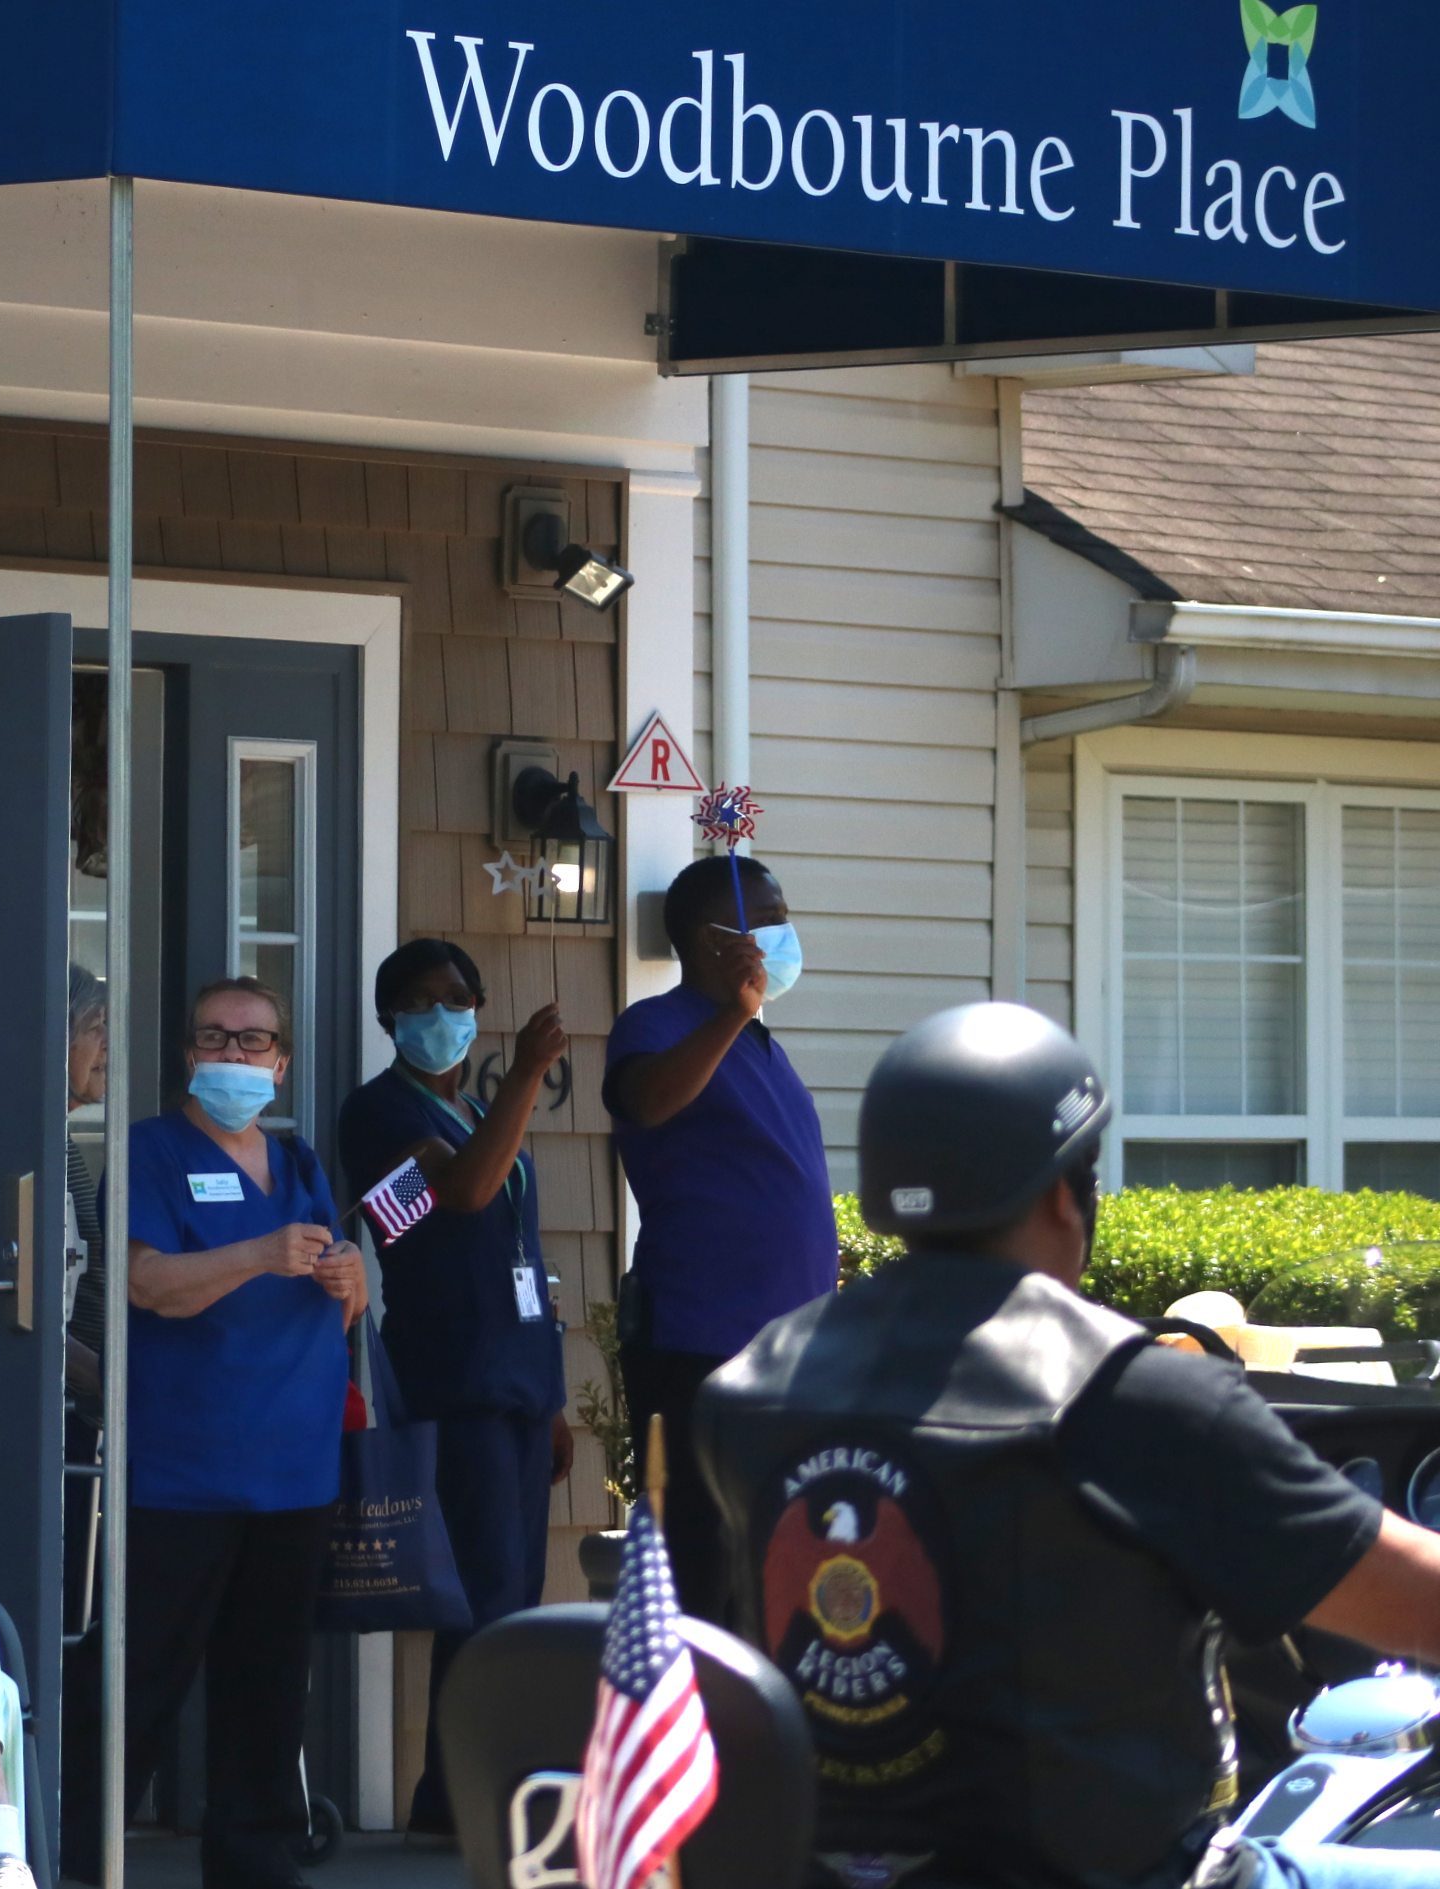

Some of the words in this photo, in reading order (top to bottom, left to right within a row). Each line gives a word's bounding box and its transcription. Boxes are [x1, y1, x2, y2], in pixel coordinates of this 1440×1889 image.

[406, 29, 1076, 223] Woodbourne
[1110, 107, 1348, 256] Place
[651, 738, 671, 782] R
[458, 1051, 572, 1111] 69
[784, 1446, 909, 1500] AMERICAN
[795, 1655, 908, 1700] RIDERS
[804, 1639, 893, 1677] LEGION
